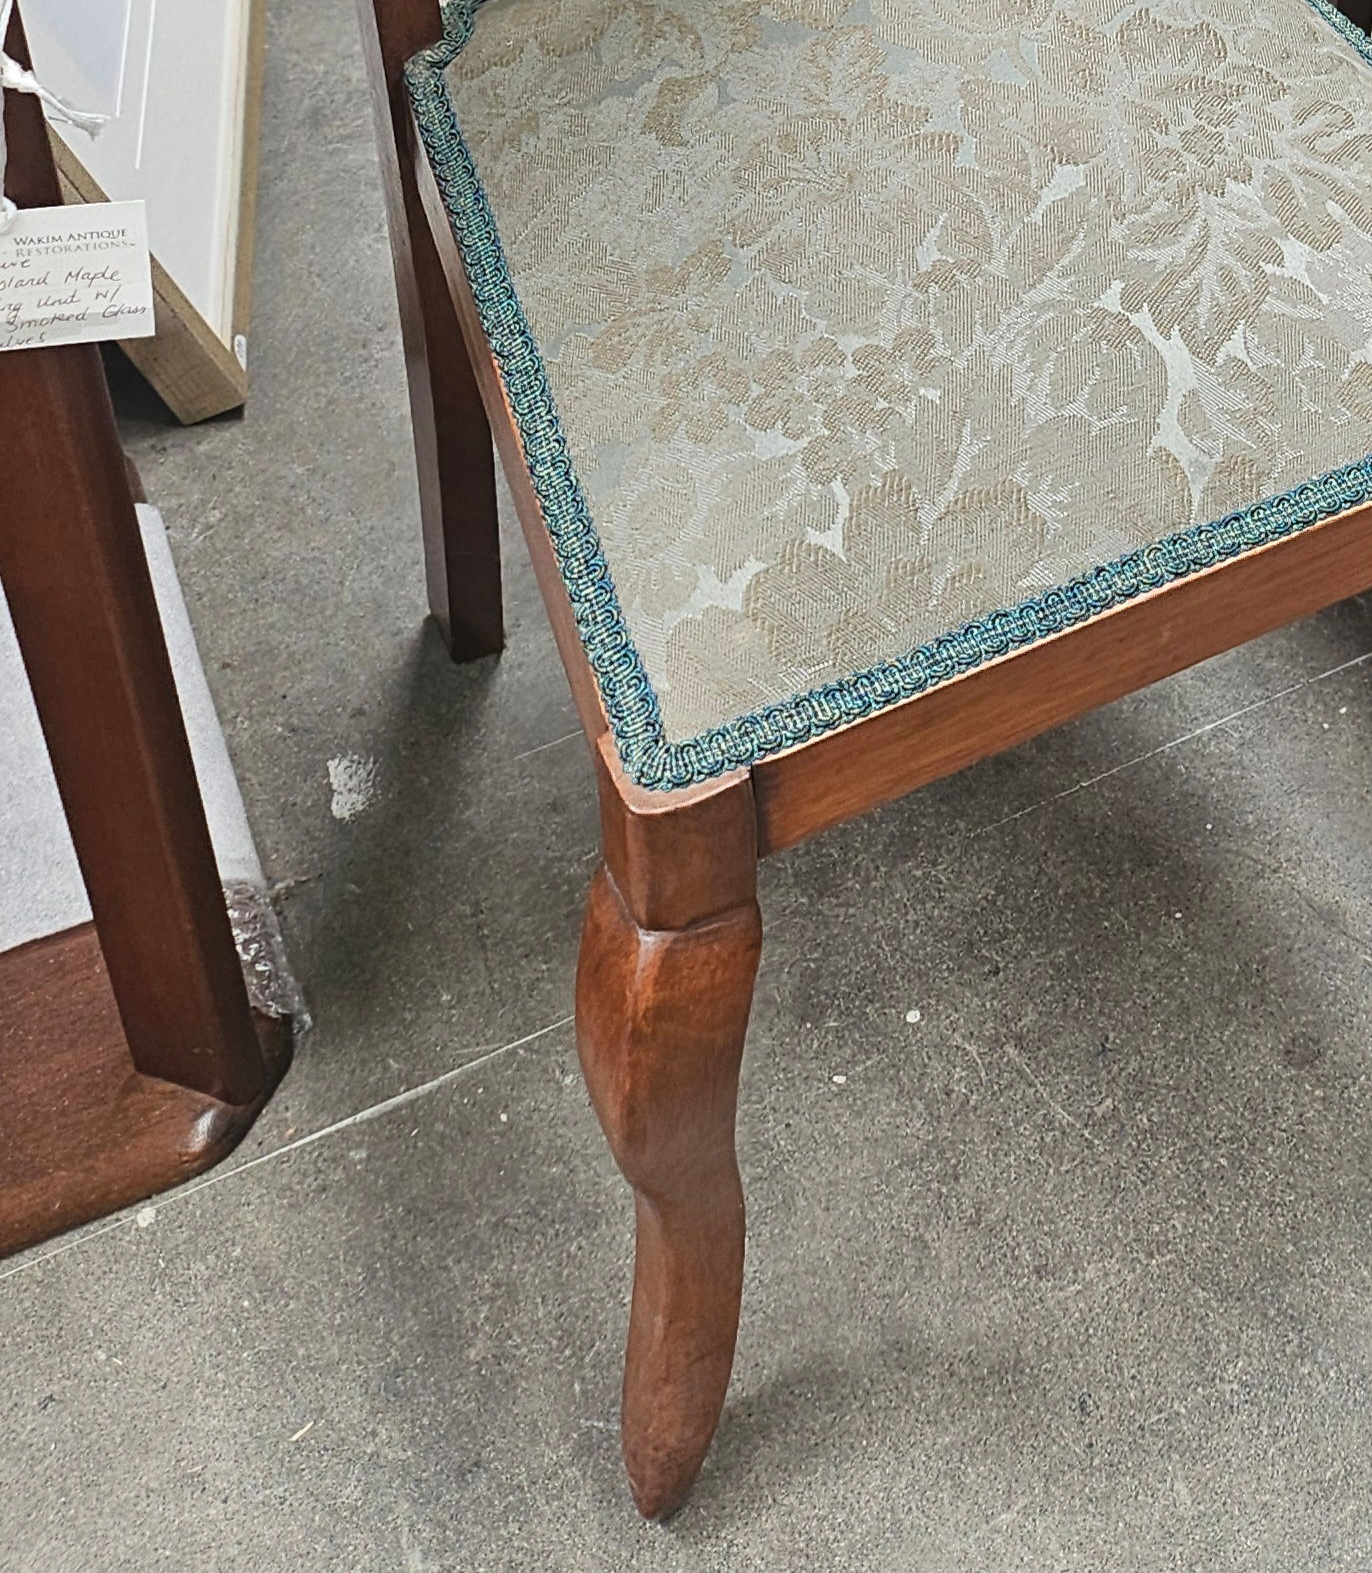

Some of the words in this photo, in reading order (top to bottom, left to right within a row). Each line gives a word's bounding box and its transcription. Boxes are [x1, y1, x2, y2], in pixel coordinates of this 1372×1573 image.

[13, 234, 63, 246] WAKIM
[67, 228, 128, 242] ANTIQUE
[16, 241, 128, 257] RESTORATIONS
[64, 265, 121, 288] Maple
